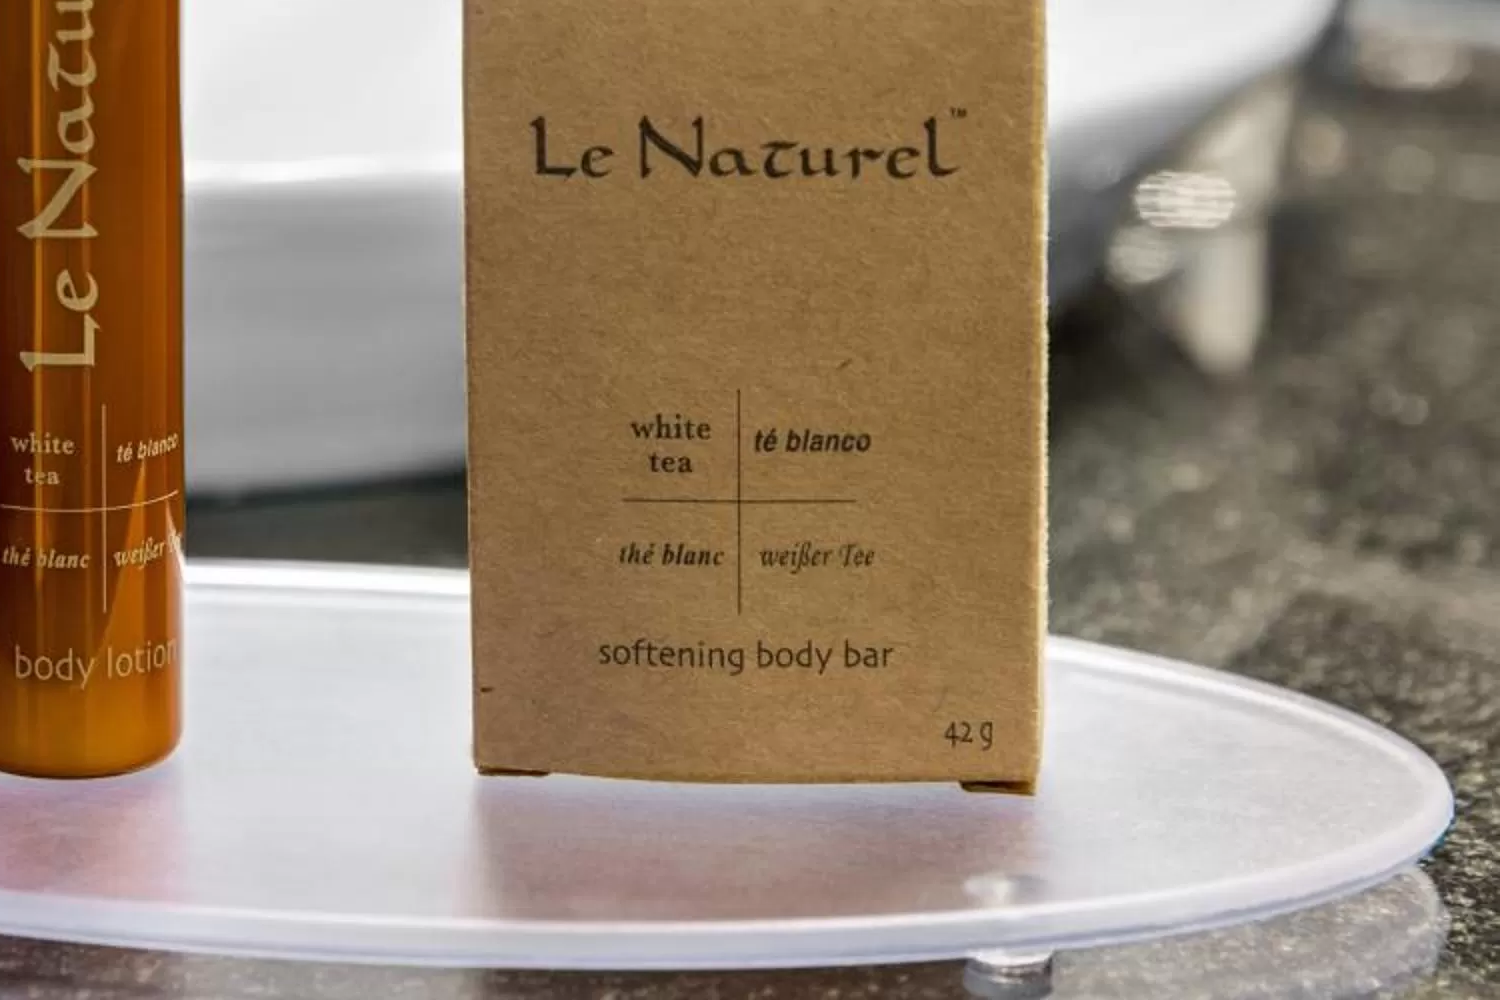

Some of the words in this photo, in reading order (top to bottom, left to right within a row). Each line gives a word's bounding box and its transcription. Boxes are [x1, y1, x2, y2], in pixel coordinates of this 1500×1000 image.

[529, 115, 615, 180] Le
[638, 114, 960, 181] Naturel
[18, 268, 101, 372] Le
[630, 413, 712, 441] white
[10, 433, 76, 456] white
[116, 441, 133, 464] té
[137, 432, 179, 459] blanco
[754, 428, 778, 453] té
[785, 428, 872, 453] blanco
[649, 453, 693, 473] tea
[23, 467, 61, 486] tea
[2, 545, 30, 566] thé
[37, 547, 90, 569] blanc
[619, 543, 654, 566] thé
[662, 543, 725, 567] blanc
[839, 543, 875, 566] Tee
[15, 645, 95, 690] body
[107, 638, 177, 679] lotion
[599, 638, 745, 675] softening
[756, 640, 833, 674] body
[844, 639, 894, 669] bar
[944, 722, 973, 748] 42
[979, 721, 994, 750] g
